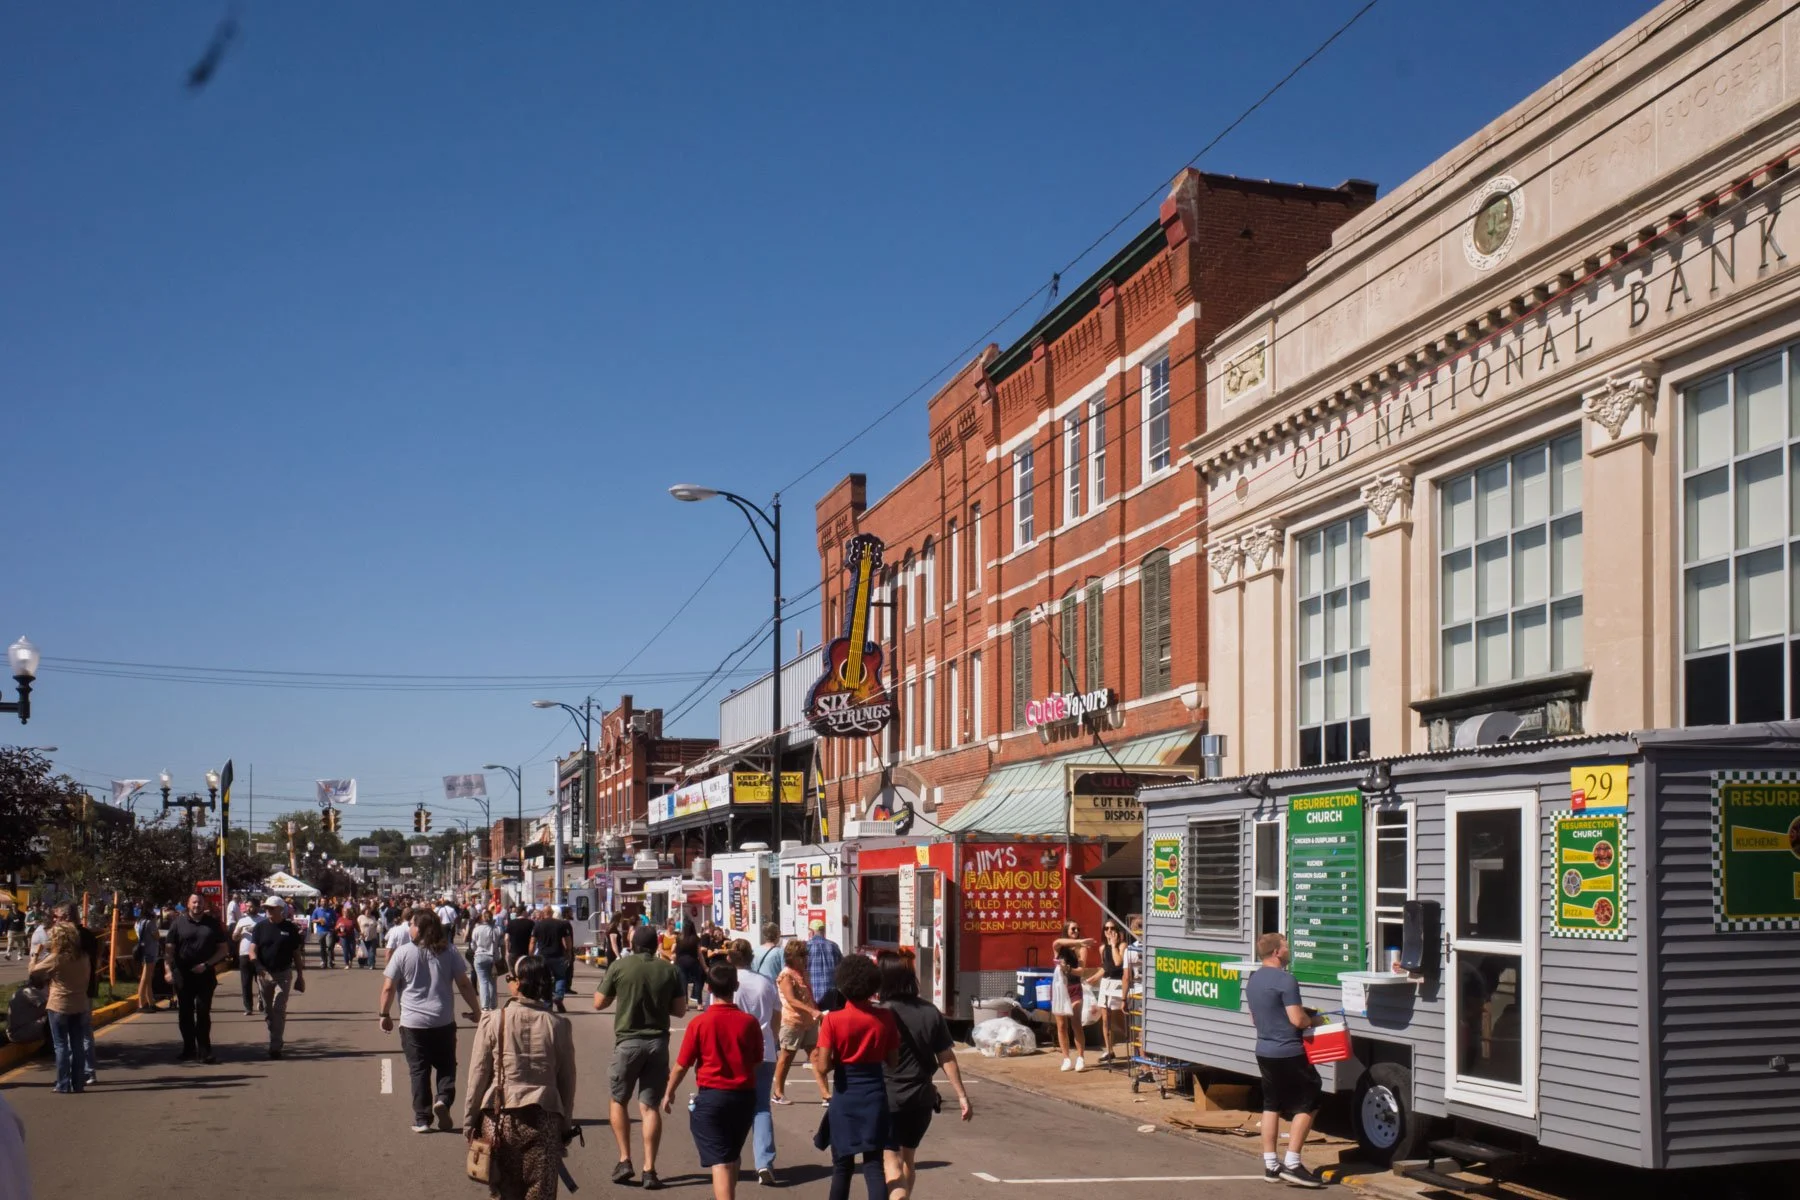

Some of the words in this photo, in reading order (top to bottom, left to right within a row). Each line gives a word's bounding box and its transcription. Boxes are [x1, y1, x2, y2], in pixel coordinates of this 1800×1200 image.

[1293, 427, 1351, 479] OLD
[1376, 309, 1593, 446] NATIONAL
[1629, 209, 1787, 328] BANK
[817, 692, 852, 717] SIX
[1025, 692, 1065, 727] Cutie
[828, 704, 891, 731] STRINGS
[1585, 772, 1613, 801] 29
[1293, 794, 1357, 811] RESURRECTION
[1306, 810, 1342, 824] CHURCH
[1562, 821, 1614, 830] RESURRECTION
[1572, 830, 1603, 838] CHURCH
[1736, 837, 1779, 847] KUCHENS
[976, 846, 1017, 875] JIM'S
[964, 871, 1062, 889] FAMOUS
[964, 900, 1001, 909] PULLED
[1006, 900, 1034, 909] PORK
[1040, 899, 1062, 909] BBQ
[964, 921, 1005, 930] CHICKEN
[1172, 978, 1219, 999] CHURCH
